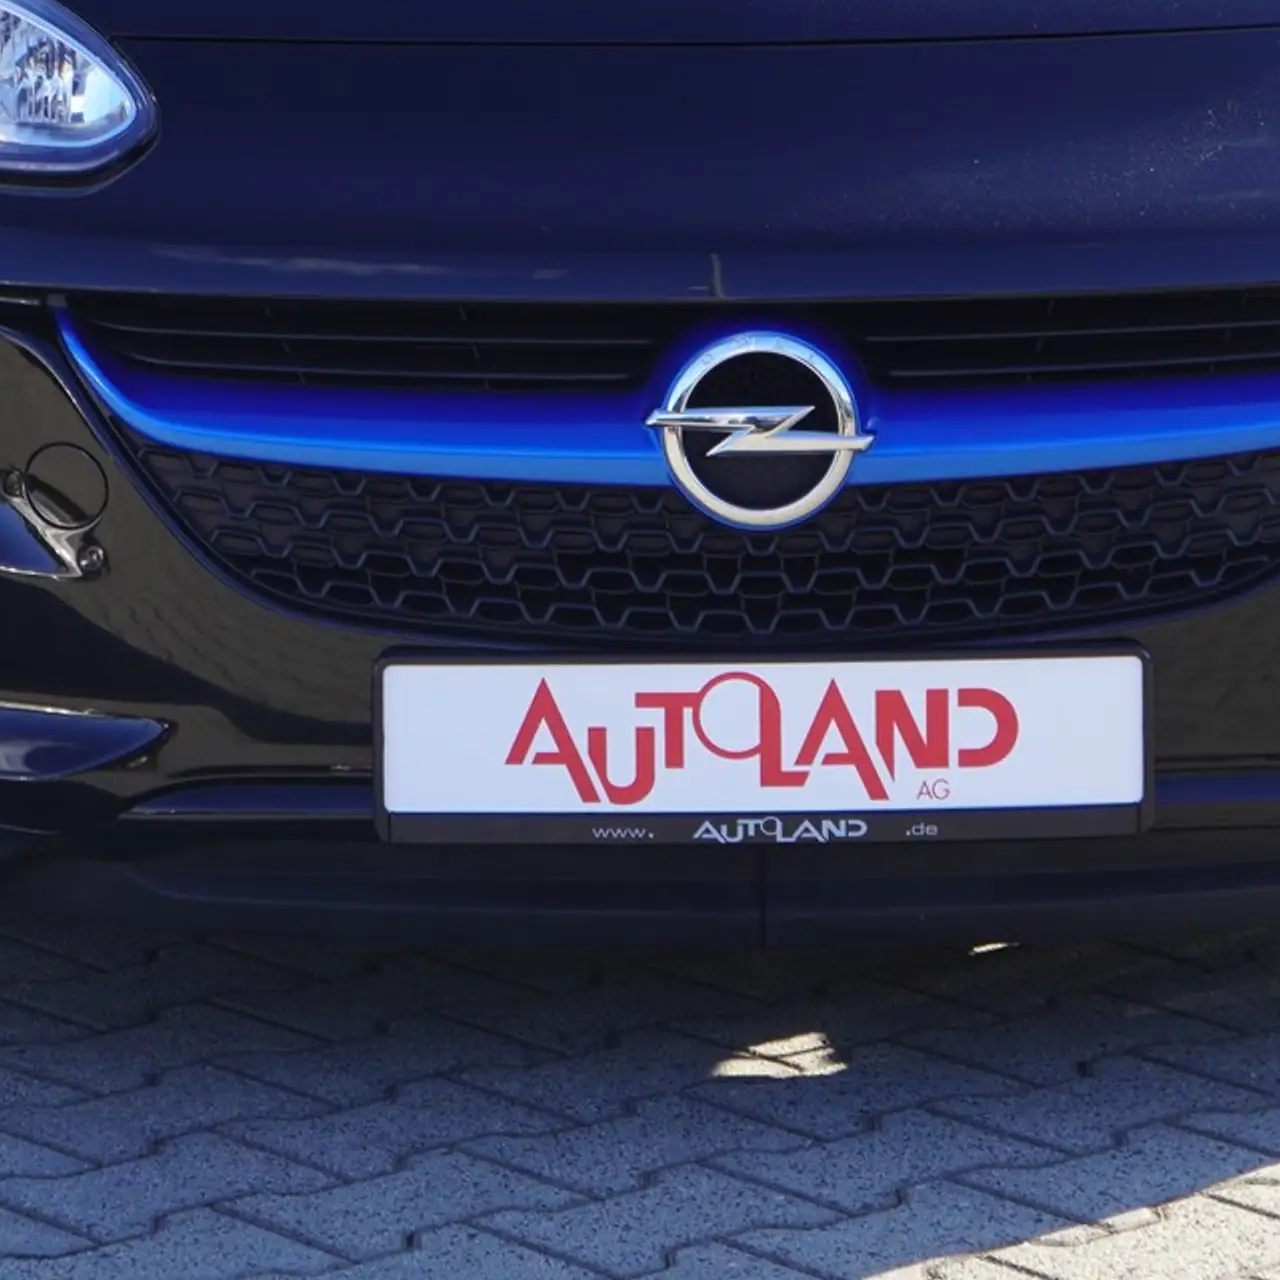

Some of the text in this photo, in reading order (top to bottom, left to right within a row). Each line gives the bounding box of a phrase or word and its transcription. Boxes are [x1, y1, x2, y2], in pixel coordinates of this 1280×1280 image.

[504, 671, 1020, 806] AUTOLAND
[916, 778, 951, 801] AG
[592, 816, 939, 844] www. AUTOLAND .de
